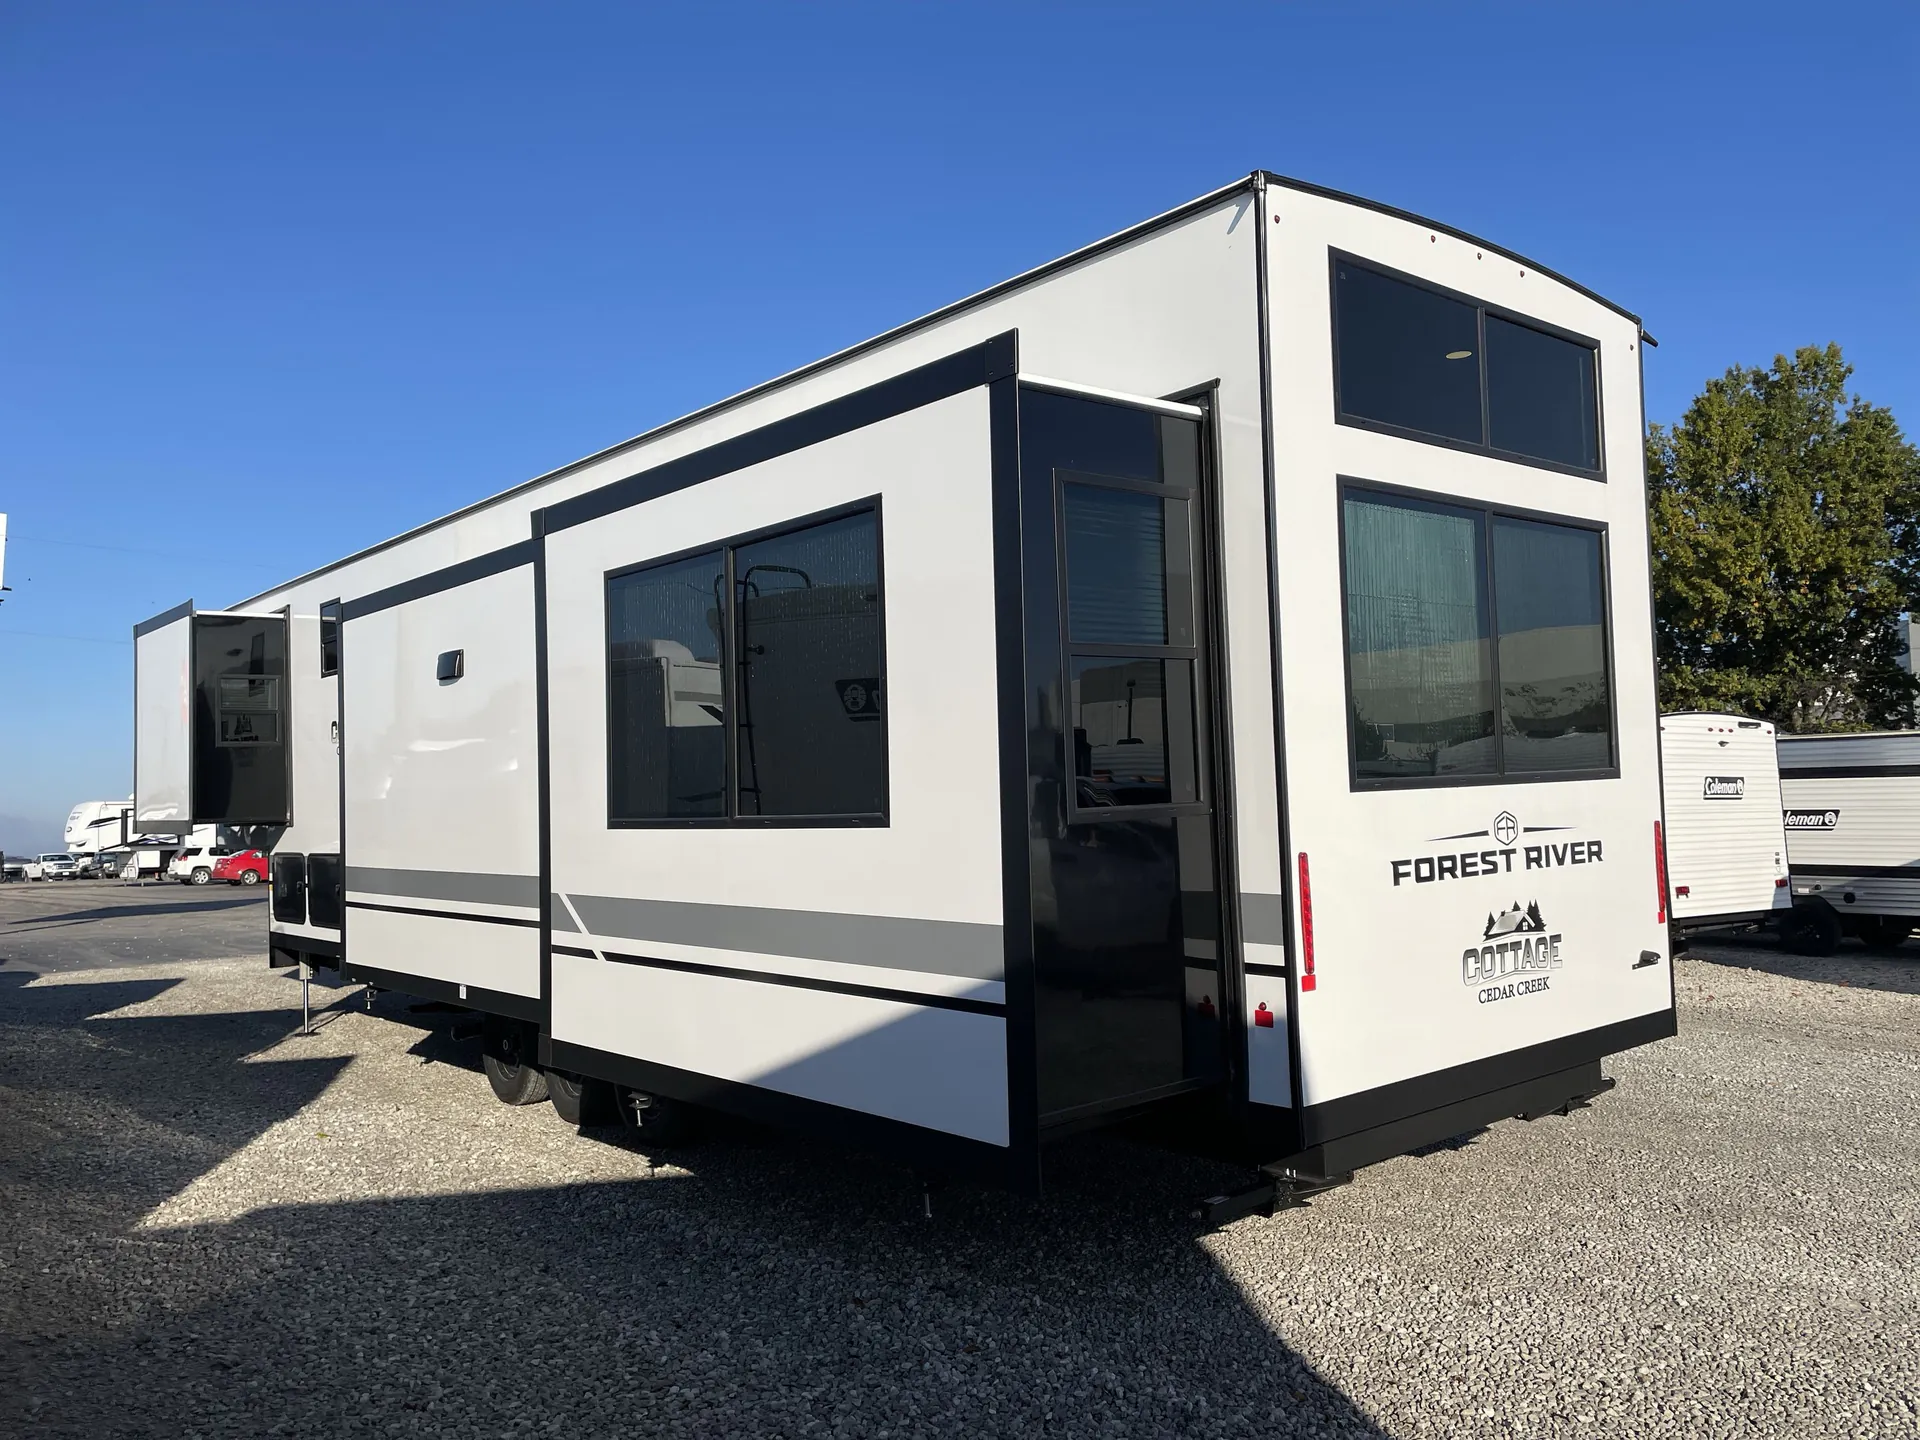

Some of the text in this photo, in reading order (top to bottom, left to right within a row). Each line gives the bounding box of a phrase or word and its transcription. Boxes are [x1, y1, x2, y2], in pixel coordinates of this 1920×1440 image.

[1705, 777, 1737, 795] Coleman
[1784, 810, 1823, 826] leman
[1390, 840, 1604, 887] FOREST RIVER
[1462, 933, 1564, 987] COTTAGE
[1478, 976, 1551, 1004] CEDAR CREEK
